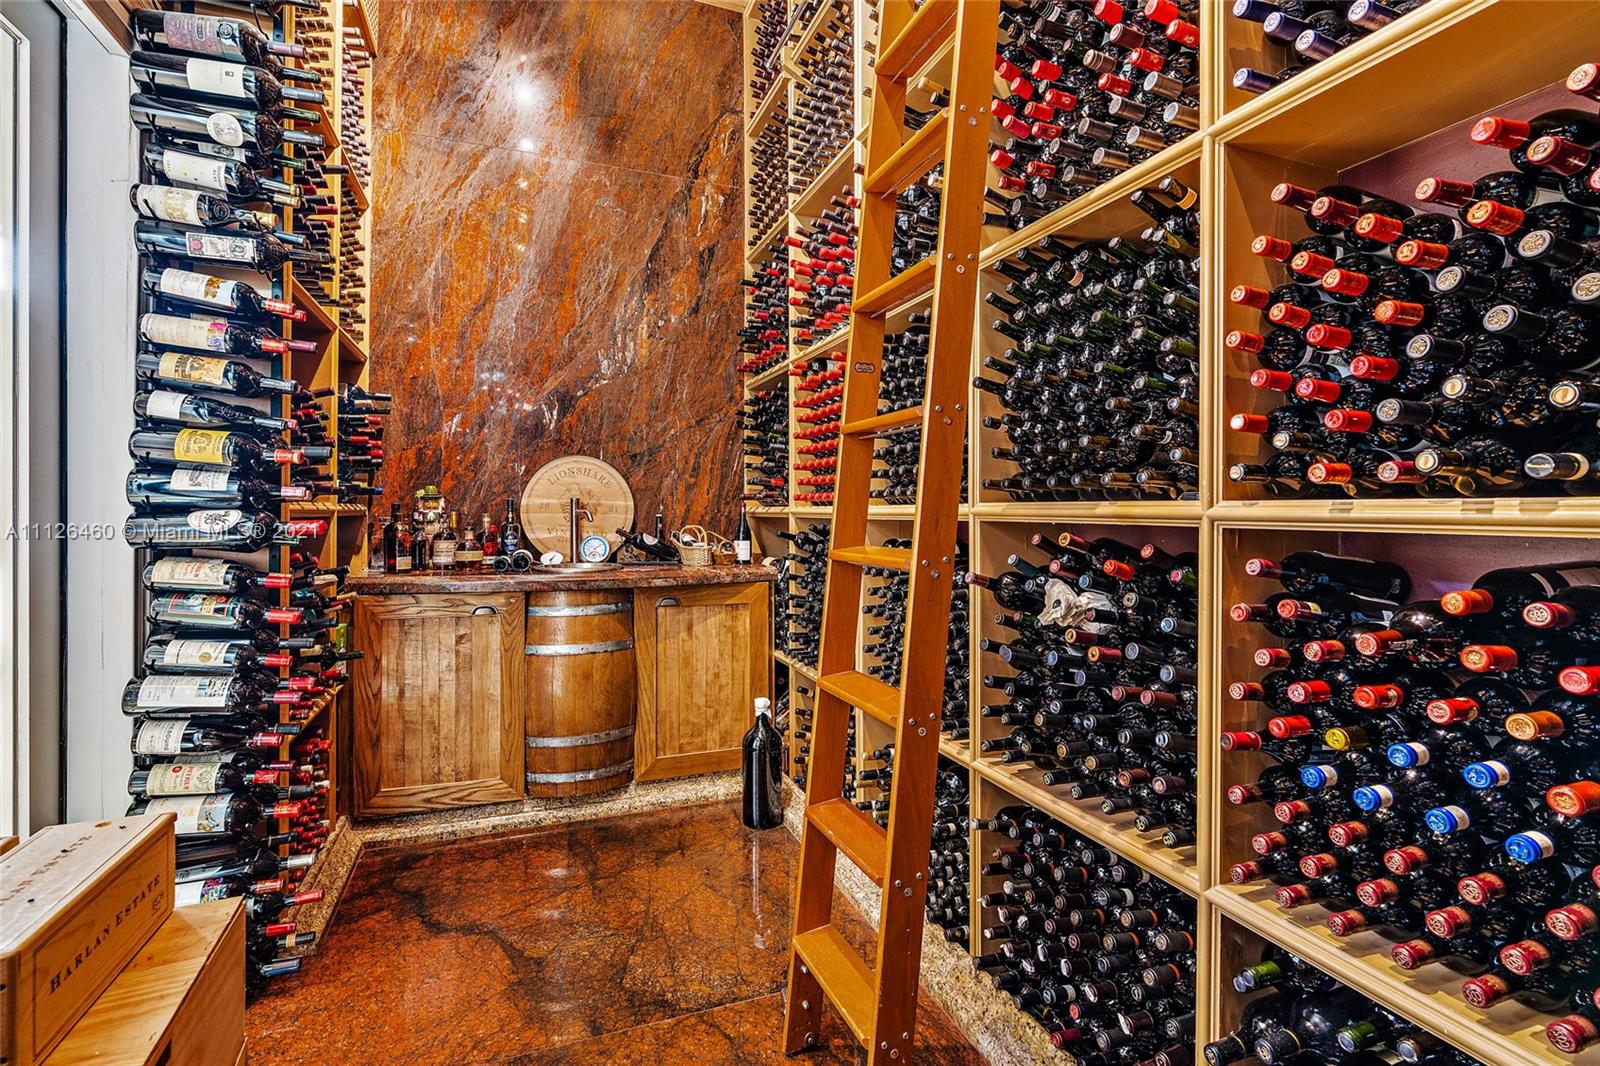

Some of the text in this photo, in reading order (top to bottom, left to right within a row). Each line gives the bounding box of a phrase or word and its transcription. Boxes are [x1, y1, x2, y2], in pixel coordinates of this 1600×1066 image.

[547, 466, 612, 489] LIONSHARE
[49, 873, 161, 994] HARLAN ESTATE
